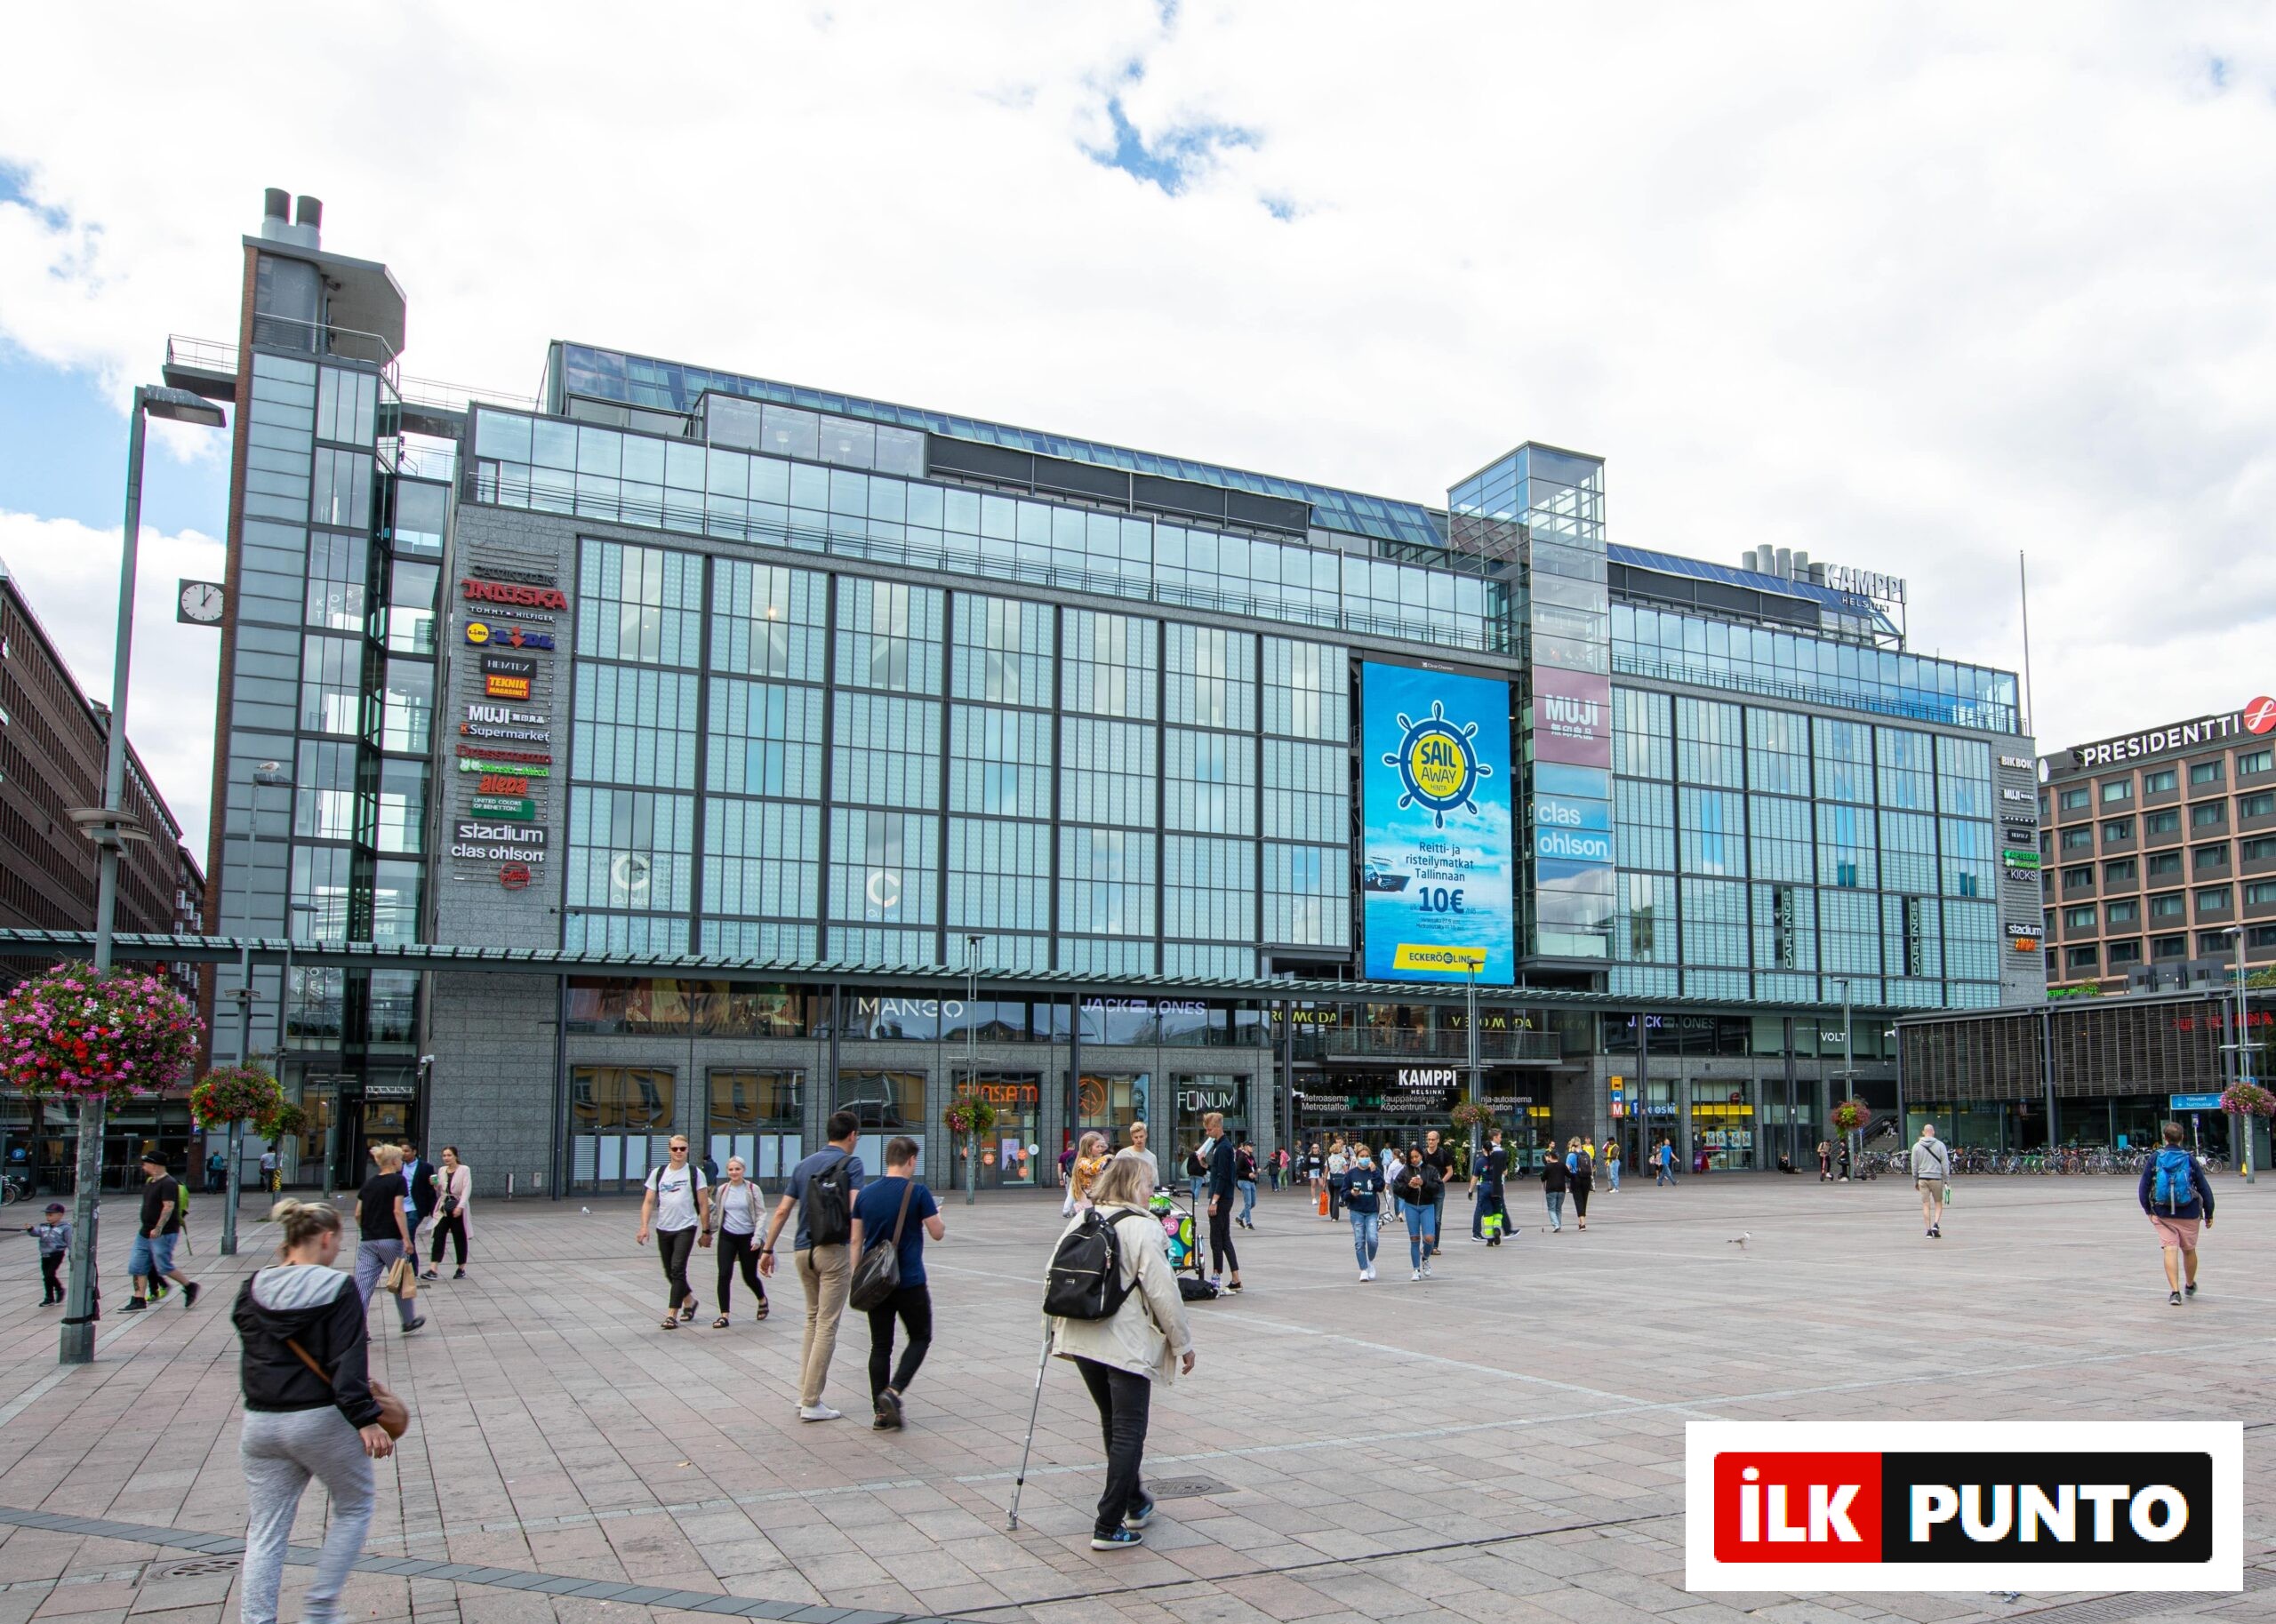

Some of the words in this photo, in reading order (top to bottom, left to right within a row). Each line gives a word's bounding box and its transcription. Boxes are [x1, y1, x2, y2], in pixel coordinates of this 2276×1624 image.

[1823, 562, 1907, 605] KAMPPI
[1842, 596, 1889, 612] HELSINKI
[470, 606, 504, 615] TOMMY
[516, 610, 555, 622] HILFIGER
[489, 676, 527, 689] TEKNIK
[489, 687, 527, 697] MAGASINET
[469, 706, 509, 724] MUJI
[1545, 694, 1599, 726] MUJI
[461, 724, 468, 732] K
[470, 724, 549, 742] Supermarket
[2083, 713, 2240, 767] PRESIDENTTI
[1420, 740, 1456, 768] SAIL
[1422, 766, 1456, 784] AWAY
[479, 774, 528, 796] alepa
[1430, 784, 1447, 792] HINTA
[2004, 788, 2020, 800] MUJI
[1539, 802, 1581, 825] clas
[459, 822, 543, 843] stadium
[1419, 842, 1449, 854] Reitti-
[1451, 844, 1461, 856] ja
[1540, 832, 1607, 857] ohlson
[451, 844, 485, 858] clas
[489, 845, 544, 862] ohlson
[1406, 854, 1474, 869] risteilymatkat
[1415, 868, 1465, 882] Tallinnaan
[2011, 869, 2036, 881] KICKS
[1419, 886, 1464, 914] 10€
[868, 908, 898, 920] Cuus
[1783, 890, 1793, 969] CARLINGS
[2008, 924, 2041, 936] stadium
[1911, 901, 1921, 976] CARLINGS
[1409, 952, 1442, 963] ECKERÖ
[858, 997, 964, 1018] MANGO
[1080, 997, 1128, 1013] JACK
[1628, 1015, 1662, 1028] JCK
[1675, 1017, 1715, 1029] ONES
[1820, 1032, 1846, 1042] VOLT
[1398, 1069, 1456, 1086] KAMPPI
[1302, 1103, 1350, 1111] Metrostation
[1381, 1103, 1426, 1111] Köpcentrum
[1480, 1095, 1532, 1104] nja-autoasema
[1485, 1103, 1513, 1111] station
[1613, 1107, 1622, 1115] M
